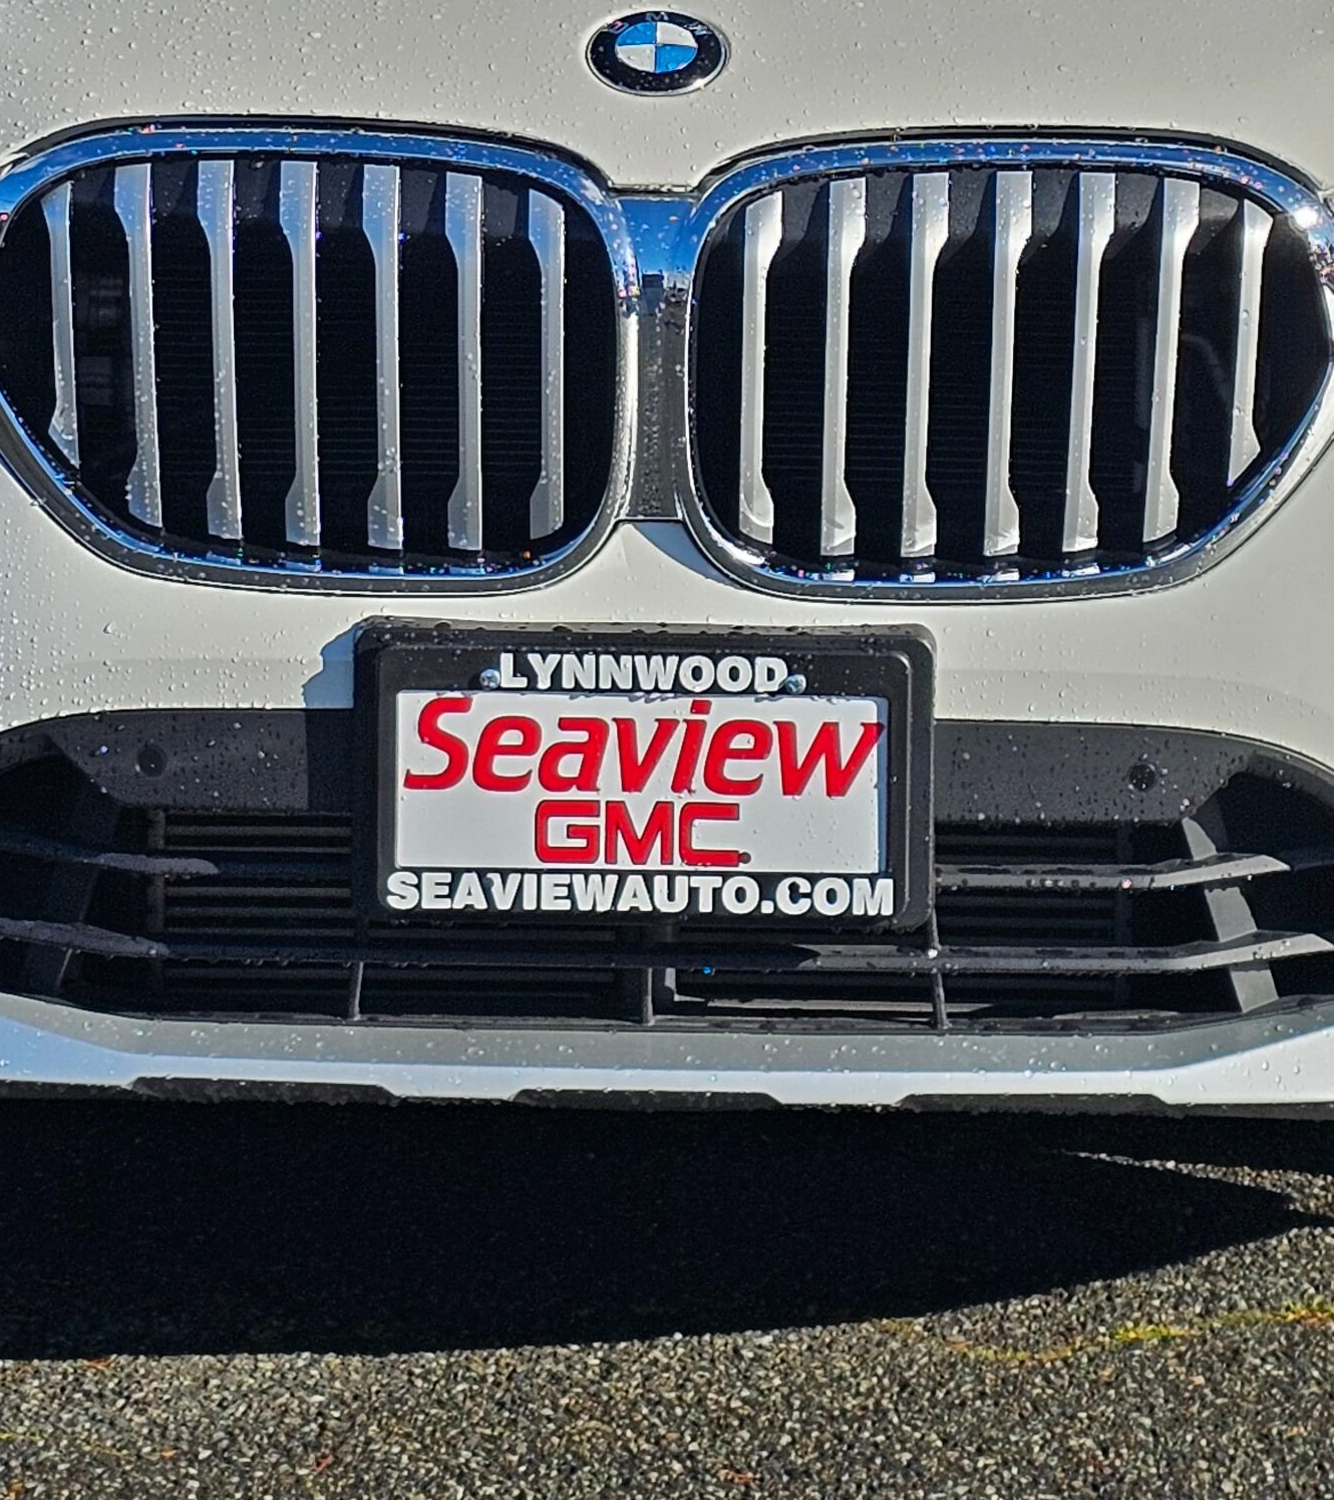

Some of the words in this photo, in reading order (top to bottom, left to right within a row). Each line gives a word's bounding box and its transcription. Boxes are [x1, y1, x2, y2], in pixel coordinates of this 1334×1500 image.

[499, 652, 788, 693] LYNNWOOD
[404, 696, 886, 798] Seaview
[535, 799, 740, 868] GMC
[386, 871, 895, 917] SEAVIEWAUTO.COM
